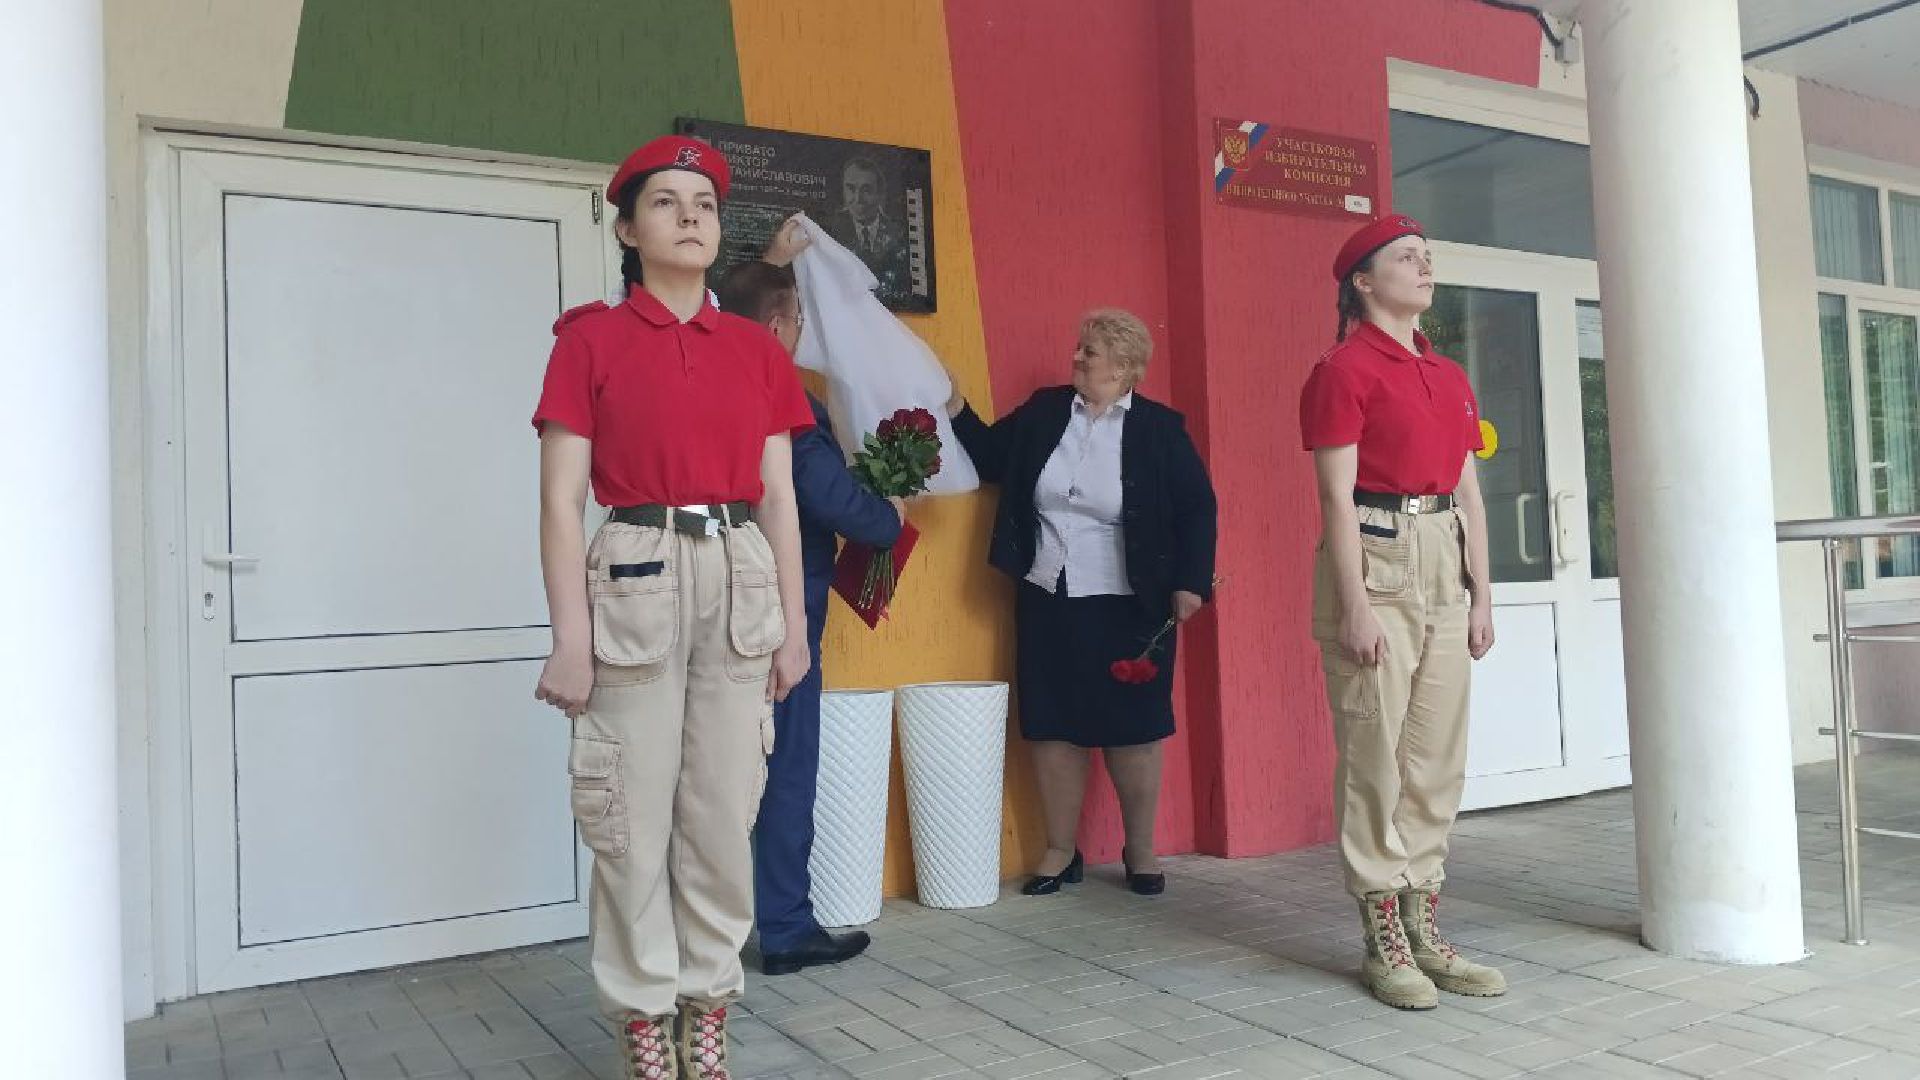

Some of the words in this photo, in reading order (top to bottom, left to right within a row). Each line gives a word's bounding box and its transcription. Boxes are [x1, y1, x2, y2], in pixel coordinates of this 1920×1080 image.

[1275, 137, 1355, 160] УЧАСТКОВАЯ
[726, 154, 769, 169] ИКТОР
[1265, 150, 1367, 175] ИЗБИРАТЕЛЬНАЯ
[727, 165, 826, 186] ТАНИСЛАВОВИЧ
[1284, 168, 1351, 187] КОМИССИЯ
